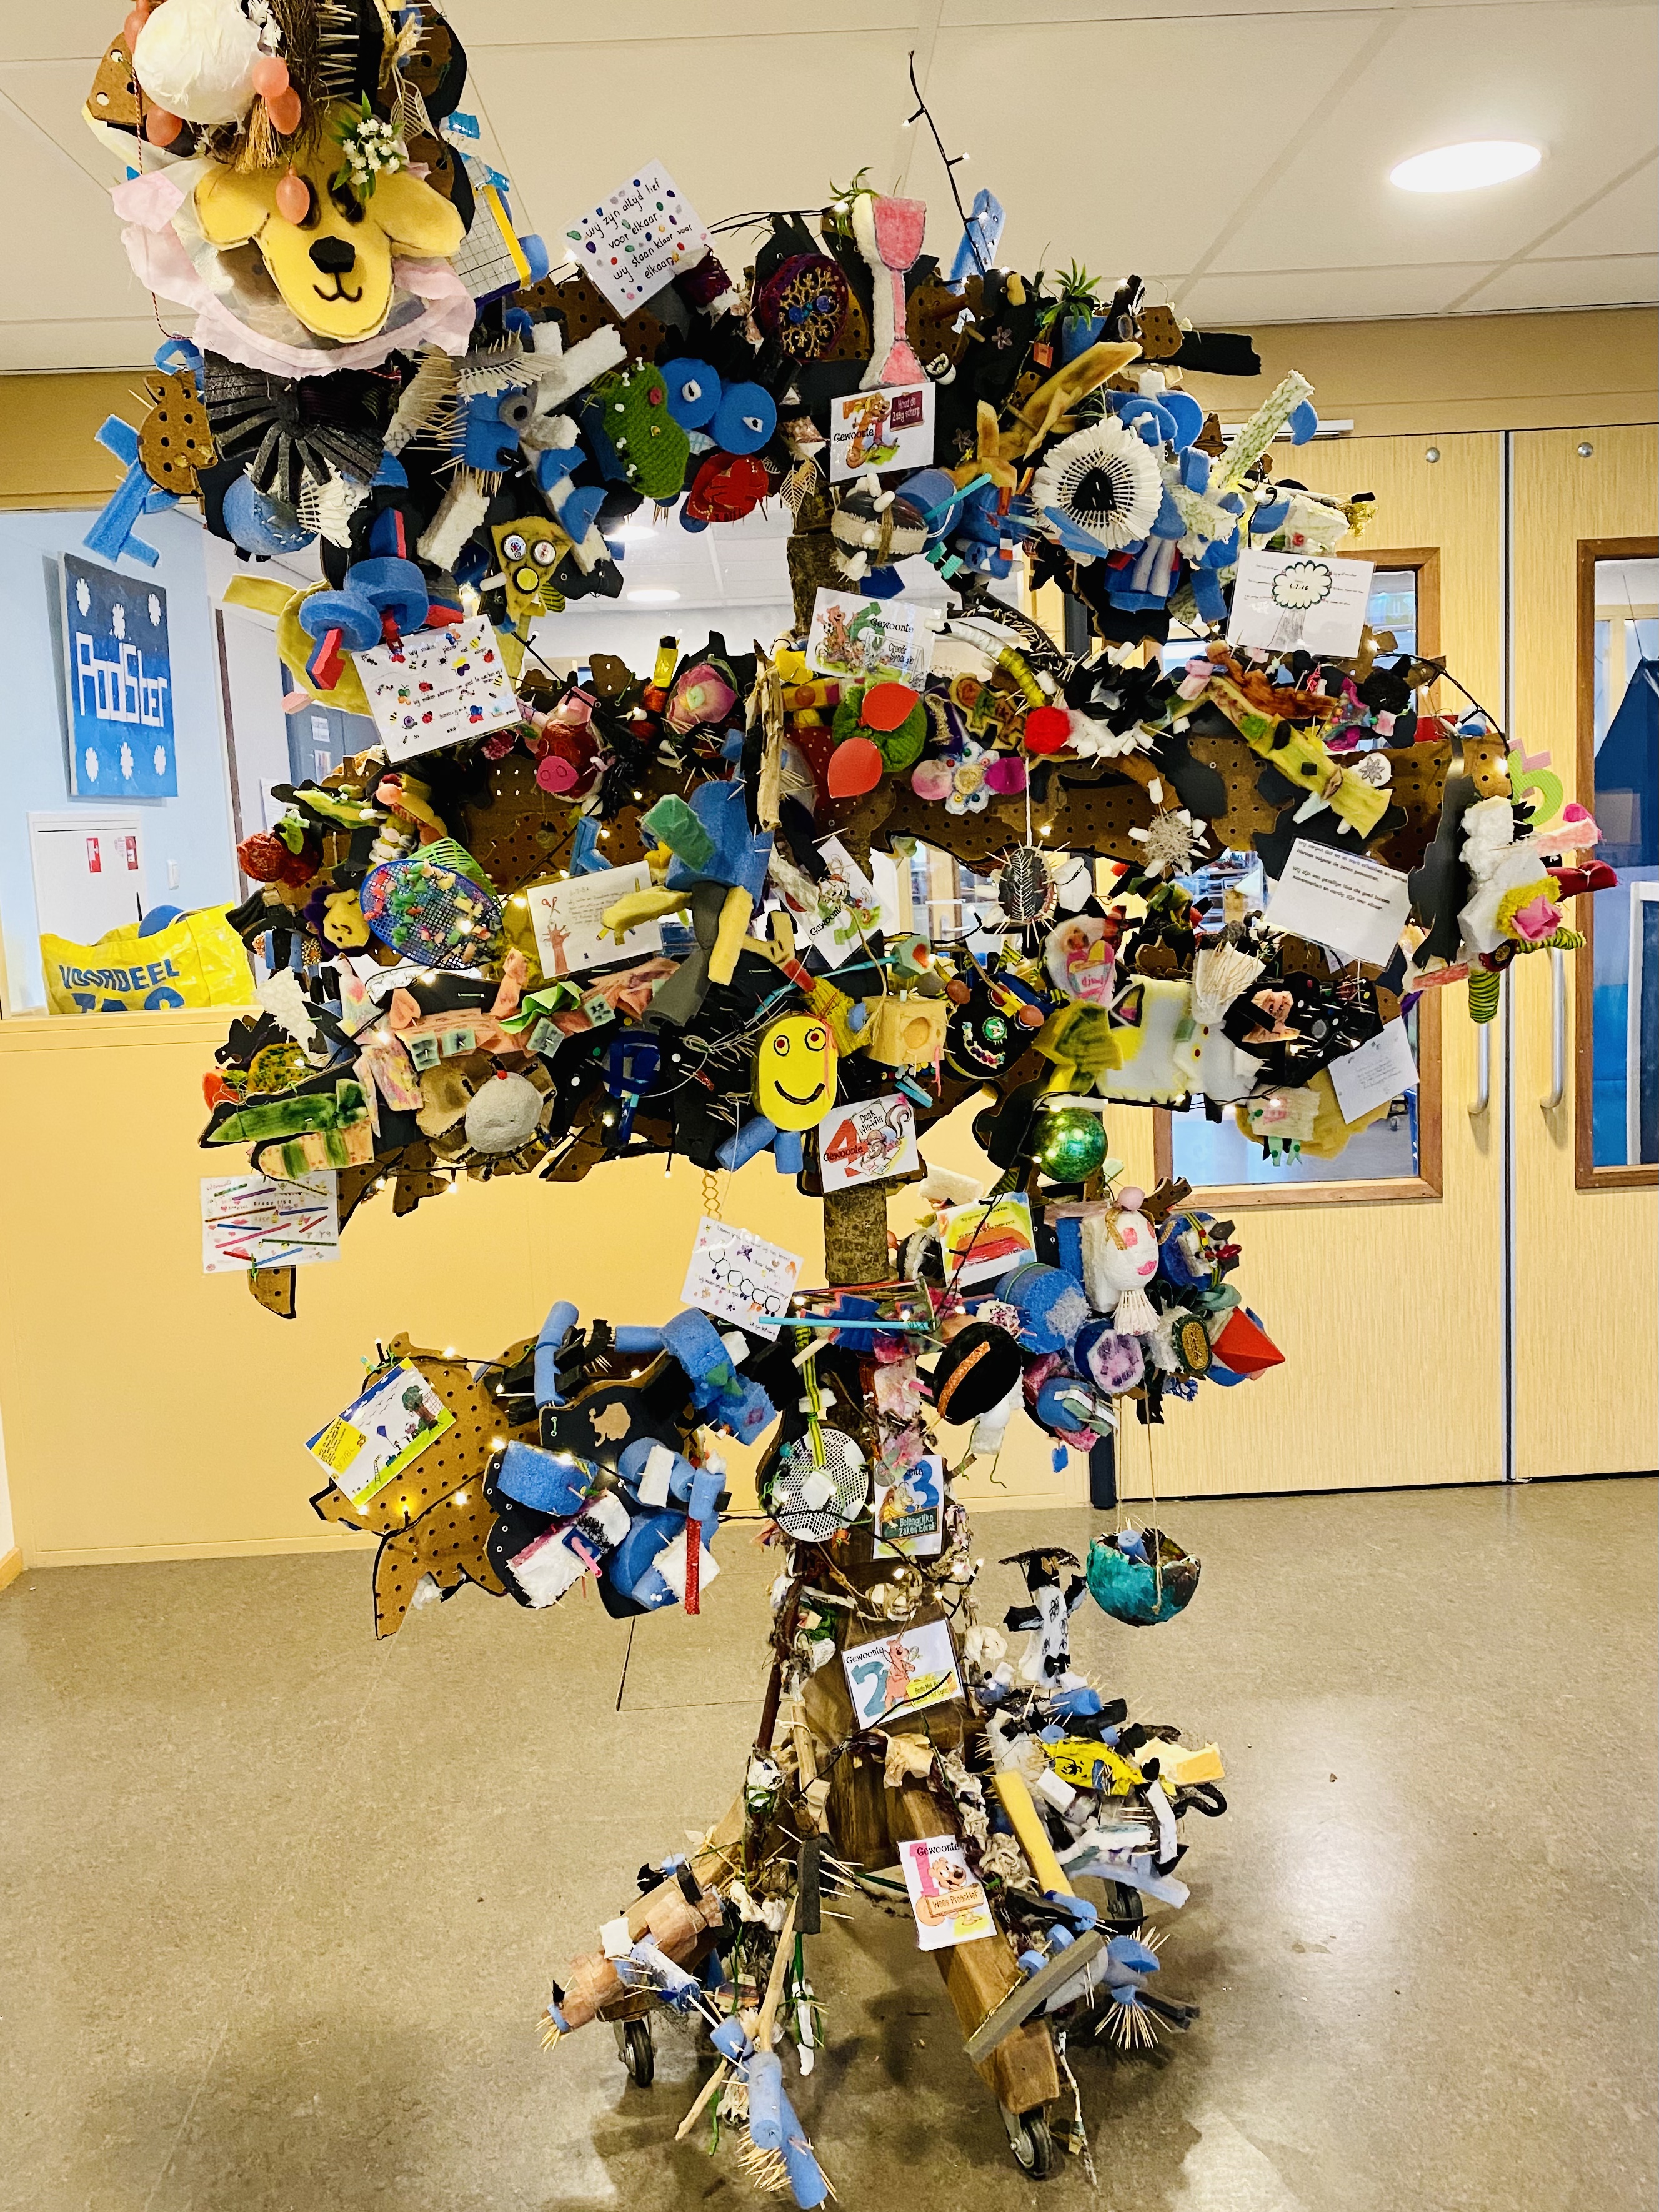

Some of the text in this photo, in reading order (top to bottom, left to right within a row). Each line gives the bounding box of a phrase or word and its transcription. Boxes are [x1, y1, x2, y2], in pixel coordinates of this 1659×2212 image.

[645, 177, 660, 194] lief
[608, 212, 659, 249] voor elkaar
[631, 246, 655, 267] staan
[655, 233, 674, 250] klaar
[677, 224, 693, 236] voor
[834, 428, 874, 442] Gewoonte
[870, 617, 914, 633] Gewoonte
[59, 959, 180, 992] VOORDEEL
[859, 1109, 877, 1123] Denk
[823, 1144, 864, 1162] Gewoonte
[899, 1513, 934, 1527] Belangrijke
[899, 1523, 935, 1537] Zaken Eerst
[846, 1646, 884, 1664] Gewoonte
[917, 1842, 960, 1856] Gewoonte
[932, 1890, 979, 1910] Wees Proactief
